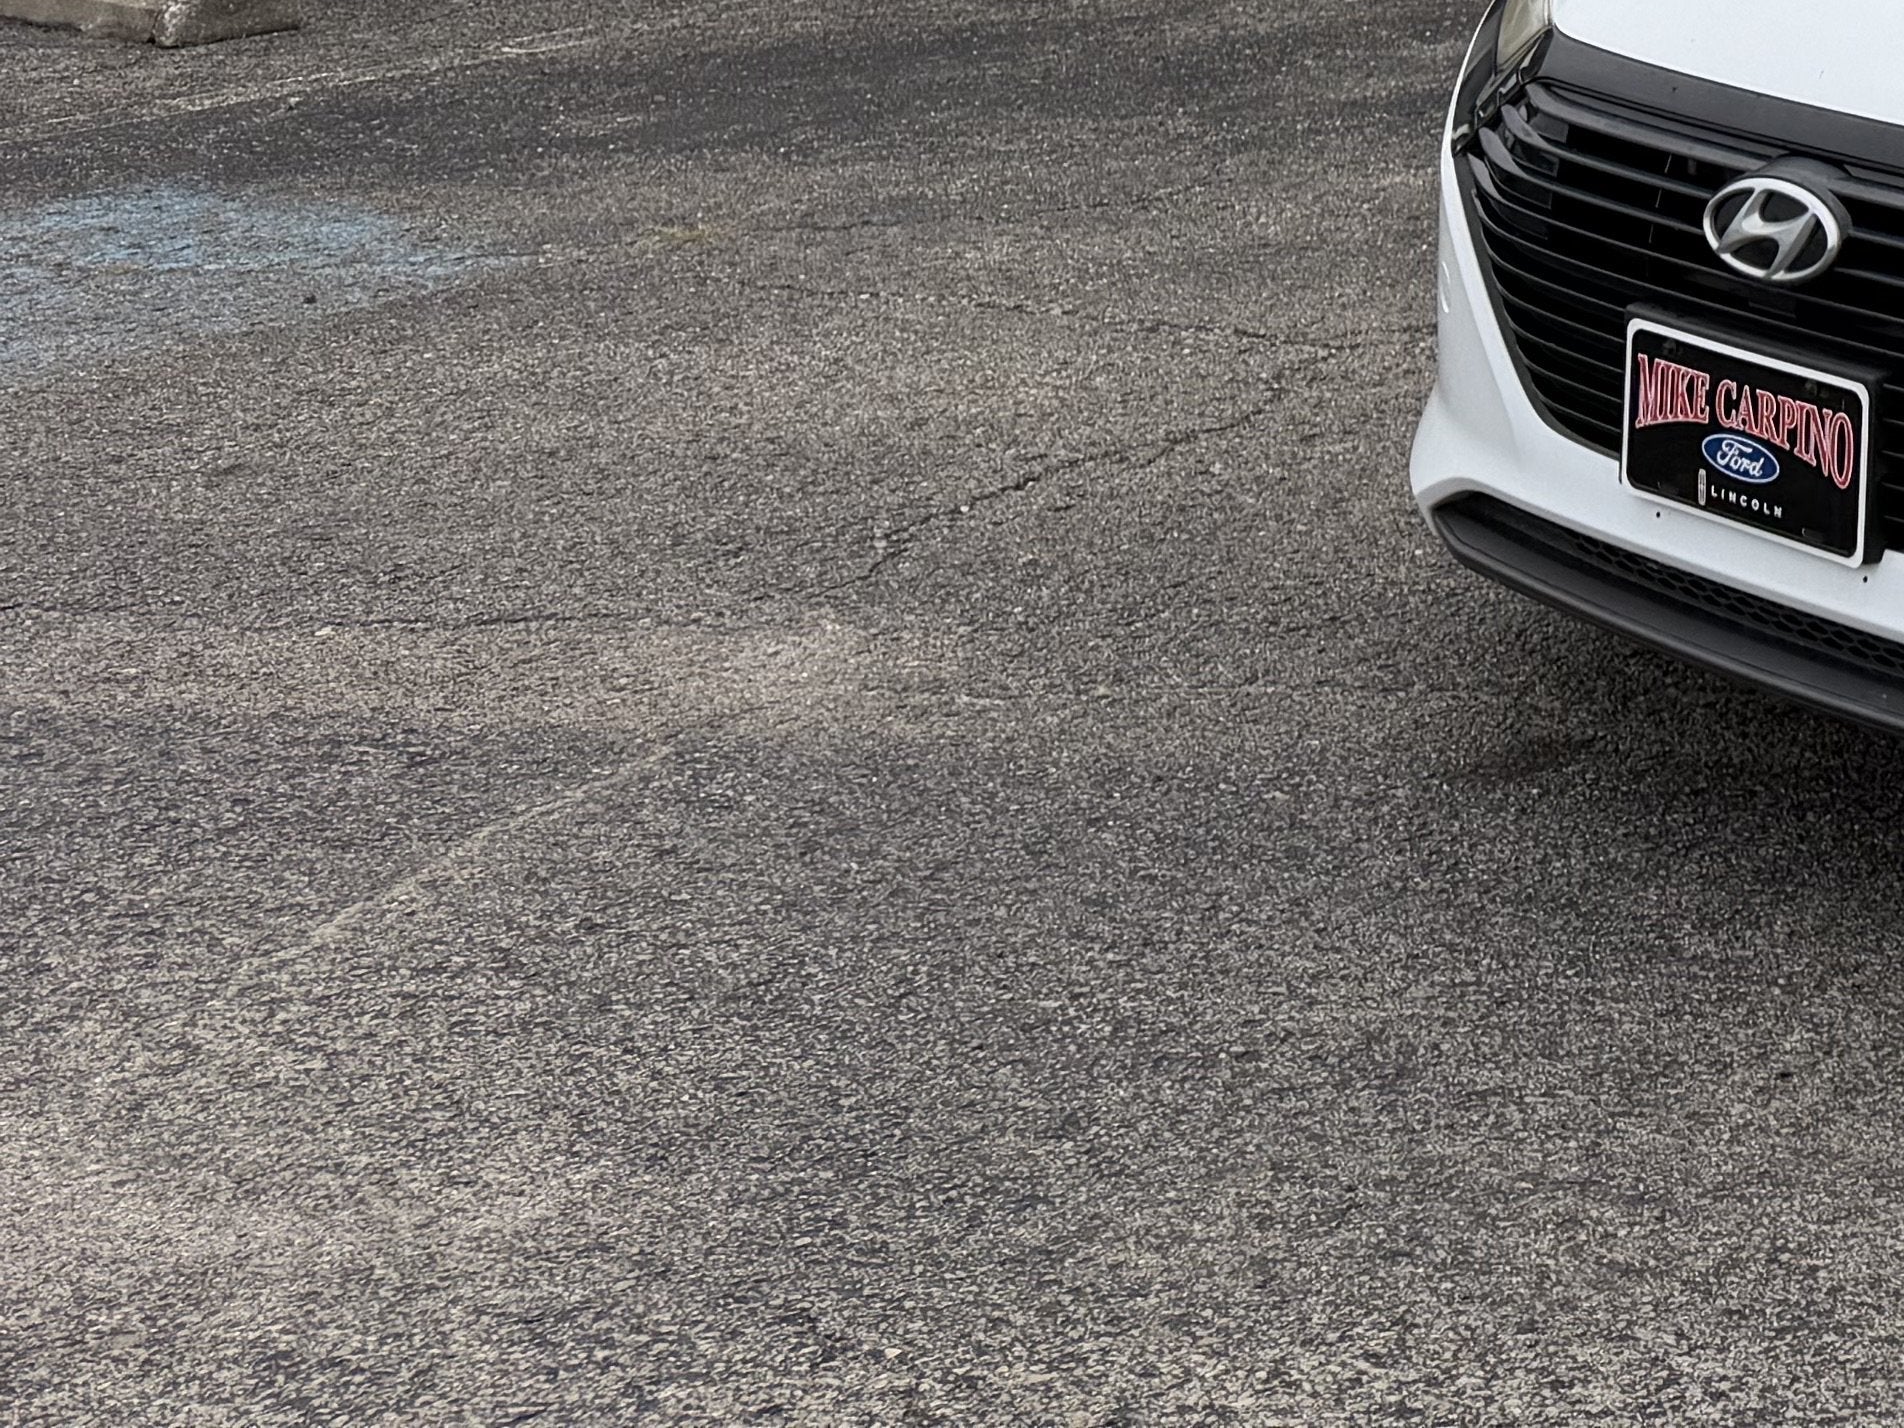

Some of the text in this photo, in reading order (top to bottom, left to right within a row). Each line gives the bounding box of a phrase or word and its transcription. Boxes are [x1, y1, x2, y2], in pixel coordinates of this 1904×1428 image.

[1635, 352, 1854, 490] MIKE CARPINO
[1715, 439, 1766, 478] Ford
[1710, 484, 1783, 519] LINCOLN
